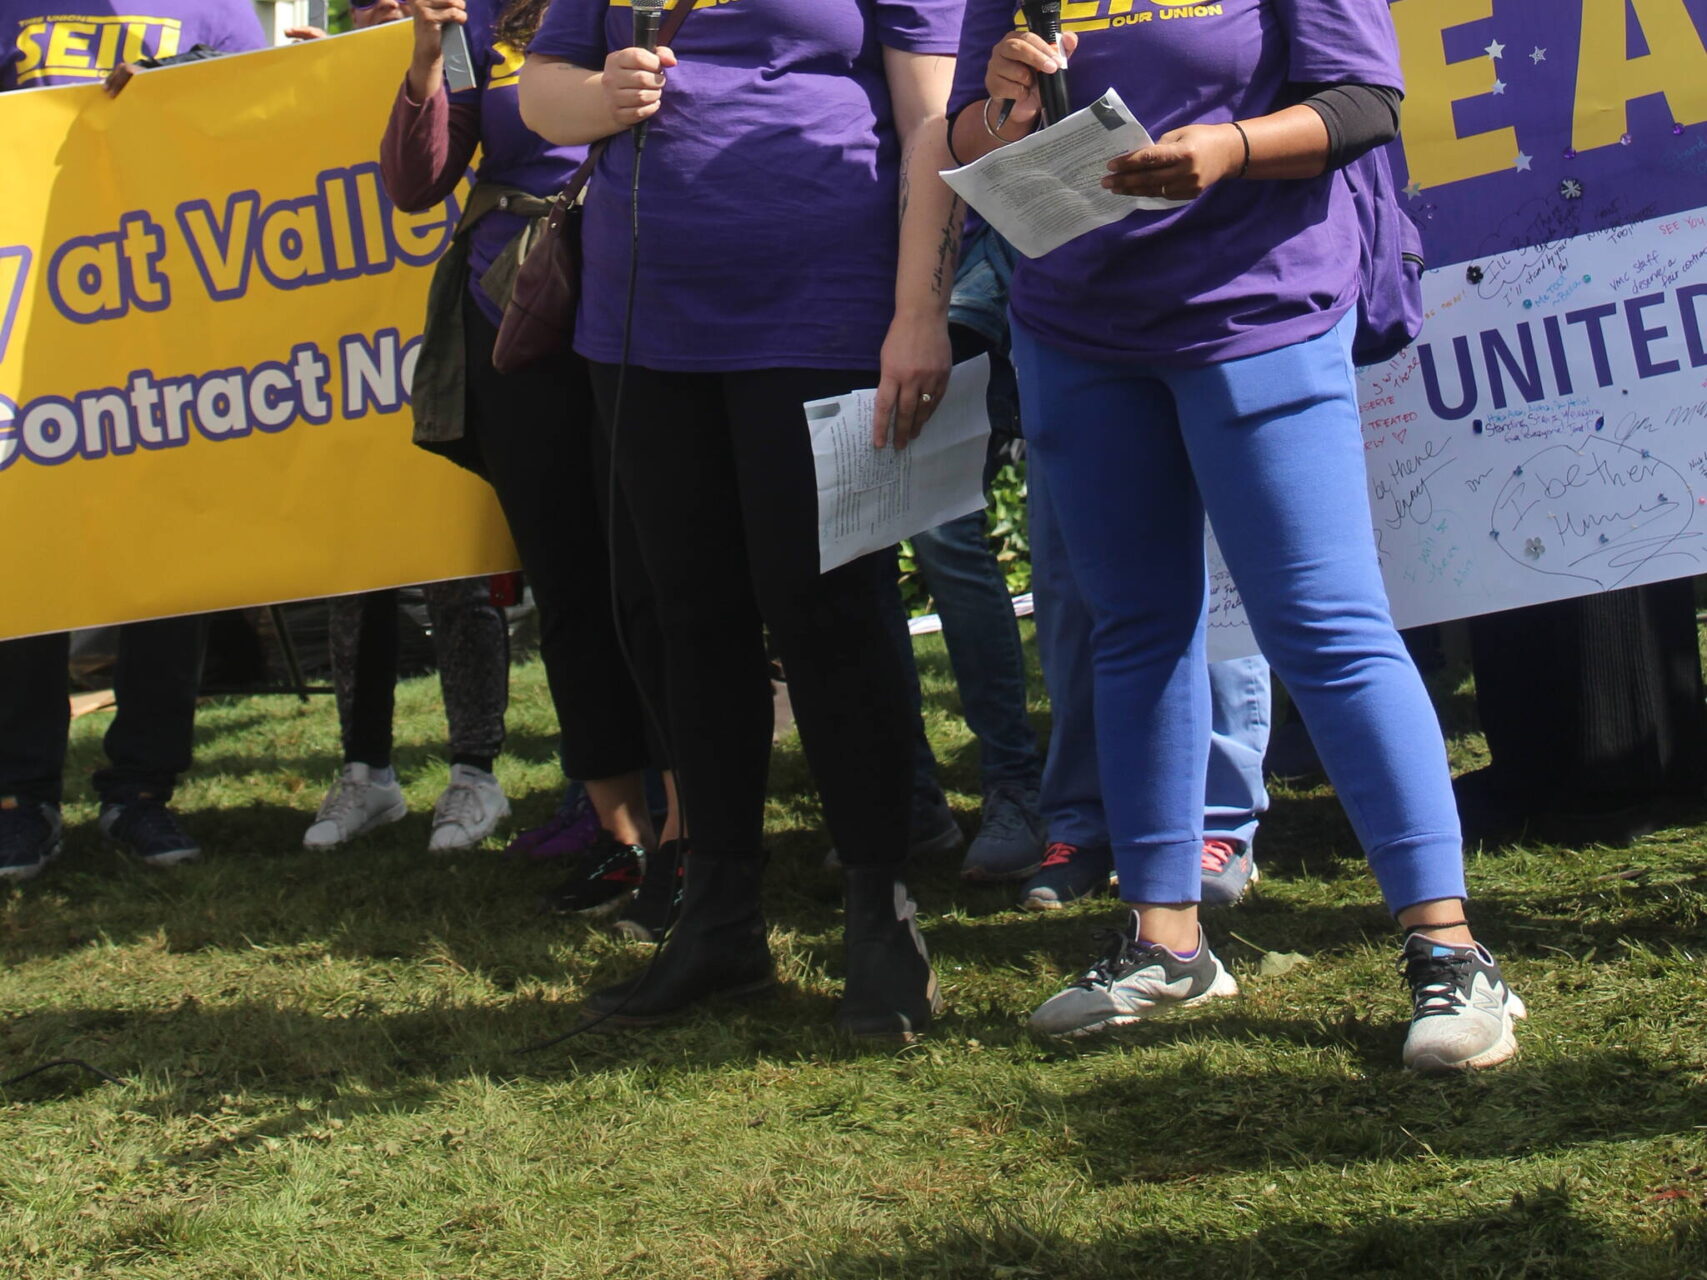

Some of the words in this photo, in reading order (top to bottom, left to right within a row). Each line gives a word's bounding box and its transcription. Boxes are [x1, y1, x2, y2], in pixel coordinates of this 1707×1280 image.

[1112, 11, 1152, 28] OUR
[1160, 4, 1223, 20] UNION
[16, 22, 182, 74] SEIU
[47, 210, 171, 324] at
